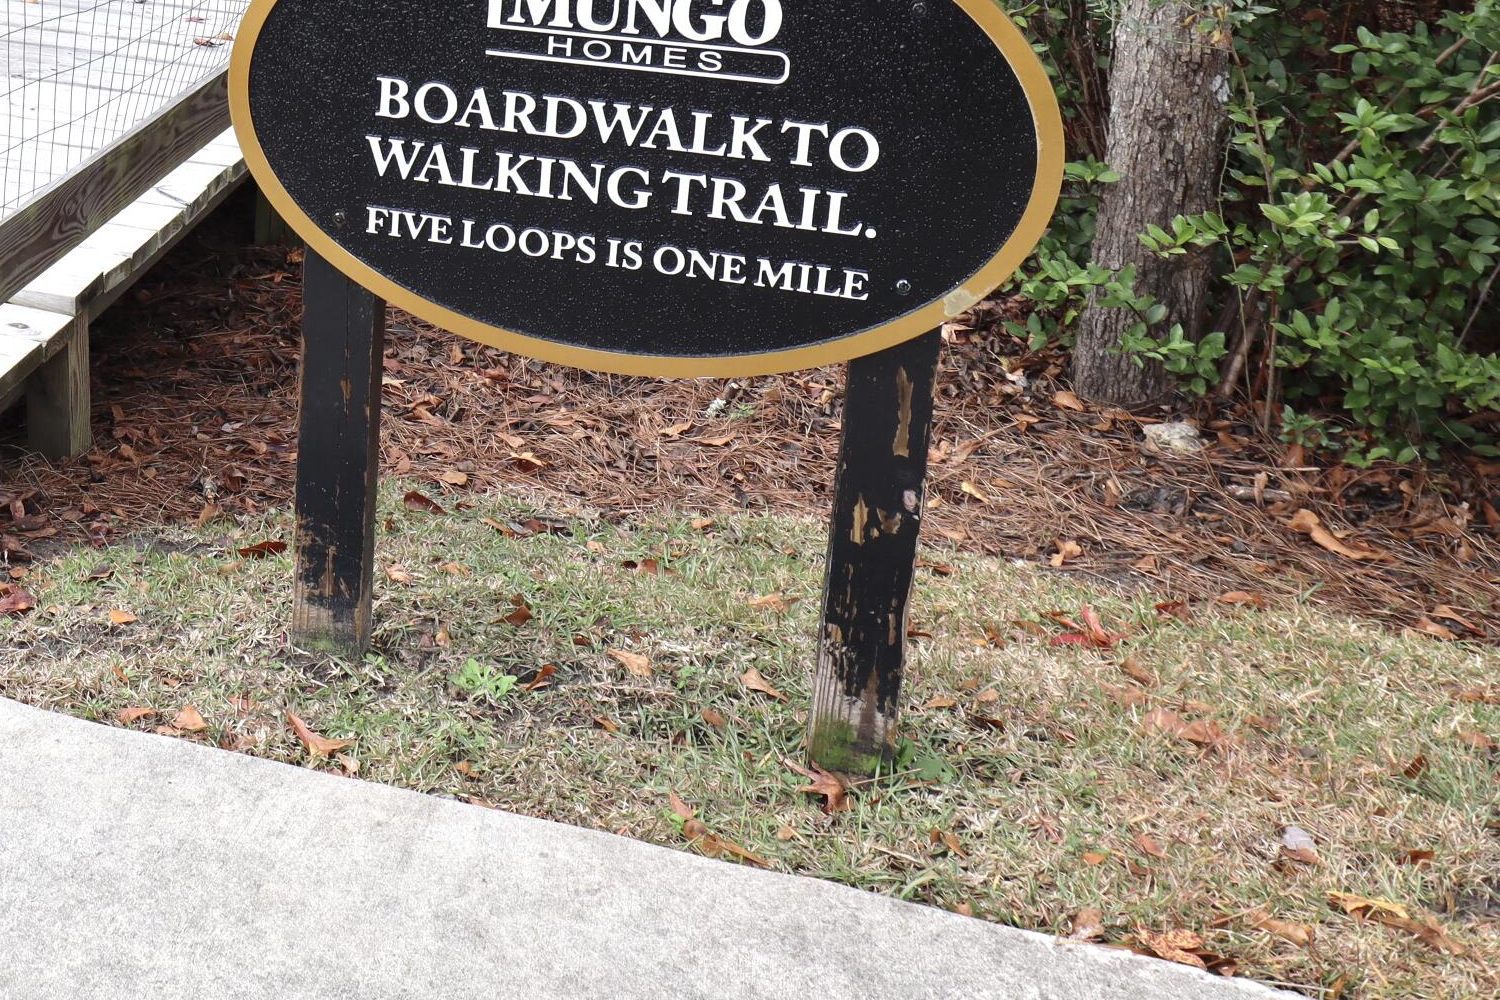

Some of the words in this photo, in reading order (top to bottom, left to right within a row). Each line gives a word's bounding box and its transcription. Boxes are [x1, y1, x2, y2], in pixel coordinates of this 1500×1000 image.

[547, 35, 722, 72] HOMES
[374, 76, 773, 162] BOARDWALK
[780, 119, 880, 173] TO
[365, 135, 653, 209] WALKING
[661, 169, 877, 239] TRAIL.
[365, 206, 453, 245] FIVE
[459, 219, 596, 264] LOOPS
[605, 238, 643, 270] IS
[653, 246, 747, 285] ONE
[753, 258, 869, 301] MILE
